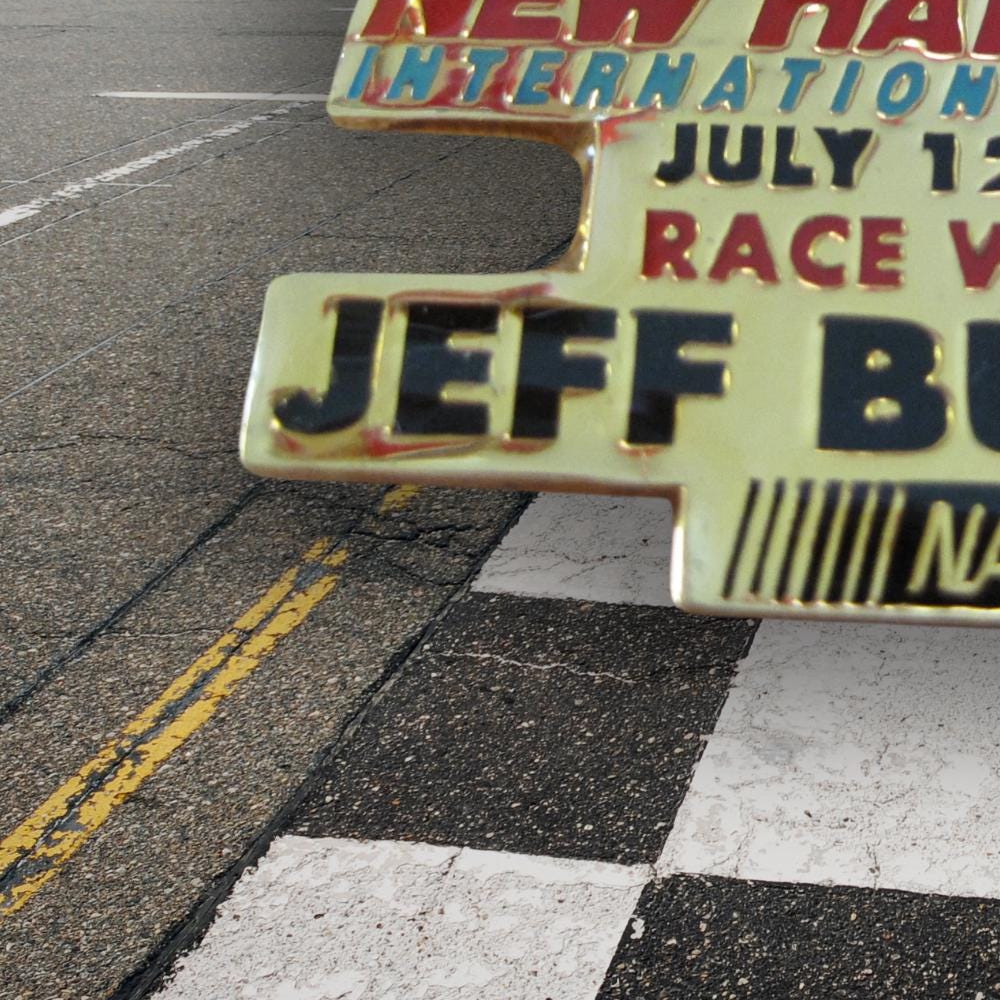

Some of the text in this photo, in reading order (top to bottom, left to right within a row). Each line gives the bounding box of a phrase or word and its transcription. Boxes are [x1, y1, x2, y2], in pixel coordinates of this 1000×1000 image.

[656, 123, 880, 190] JULY
[641, 209, 908, 290] RACE
[270, 298, 738, 450] JEFF
